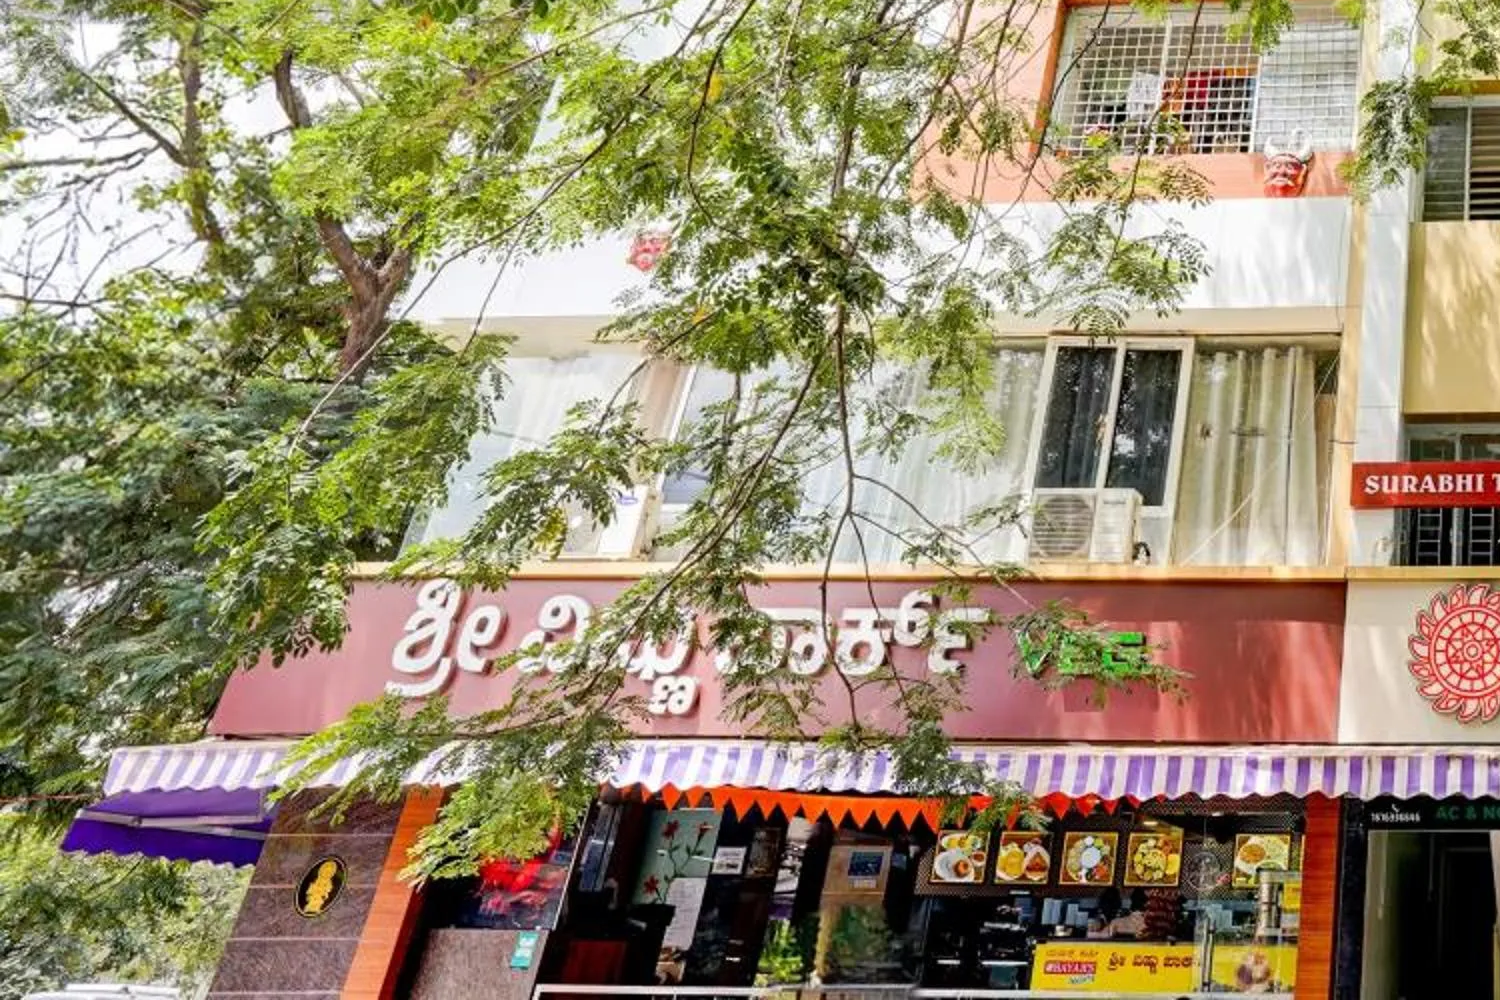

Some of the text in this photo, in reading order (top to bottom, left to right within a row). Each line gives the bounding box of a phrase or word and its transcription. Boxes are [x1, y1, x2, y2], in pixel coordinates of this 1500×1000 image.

[1364, 473, 1484, 495] SURABHI
[385, 578, 501, 697] ಶ್ರೀ
[1437, 806, 1460, 820] AC
[1466, 806, 1477, 820] &
